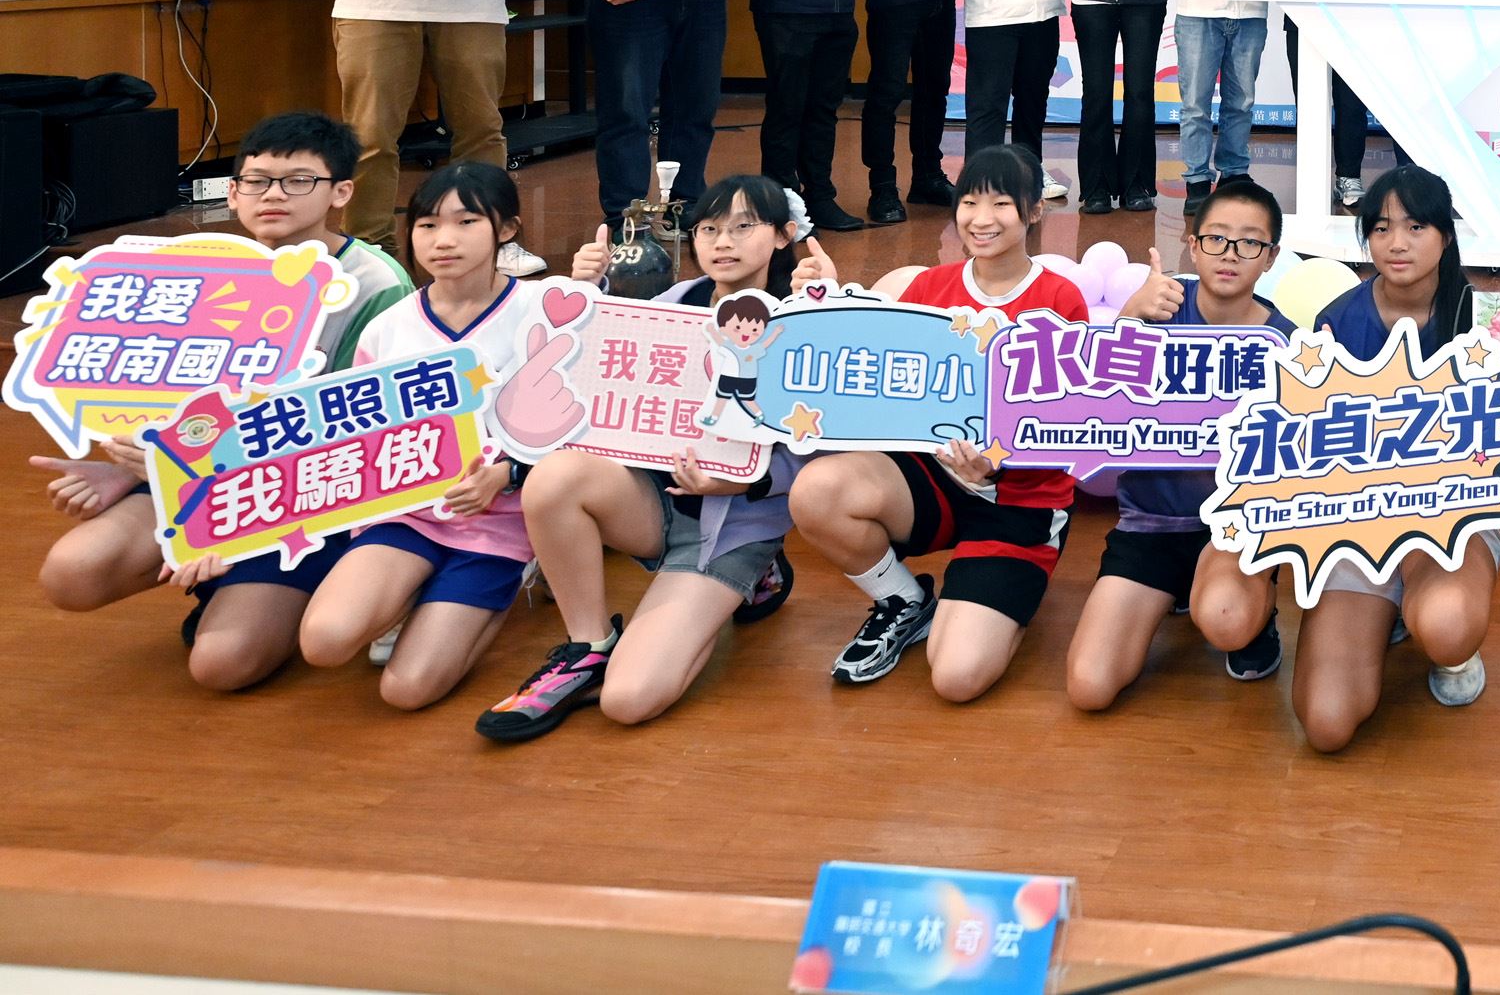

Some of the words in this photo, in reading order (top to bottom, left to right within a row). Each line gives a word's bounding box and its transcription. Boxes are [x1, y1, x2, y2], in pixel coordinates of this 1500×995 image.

[79, 274, 202, 324] 我愛
[48, 334, 282, 387] 照南國中
[598, 339, 688, 387] 我愛
[783, 344, 975, 402] 山佳國小
[1007, 317, 1269, 398] 永貞好棒
[238, 359, 461, 458] 我照南
[590, 391, 728, 442] 山佳國
[1019, 423, 1126, 452] Amazing
[1135, 423, 1219, 452] Yong-Z
[211, 423, 443, 537] 我驕傲
[1251, 507, 1291, 525] The
[1298, 500, 1346, 520] Star
[1353, 494, 1376, 513] of
[1383, 483, 1498, 510] Yong-Zhen
[914, 915, 1025, 959] 林奇宏
